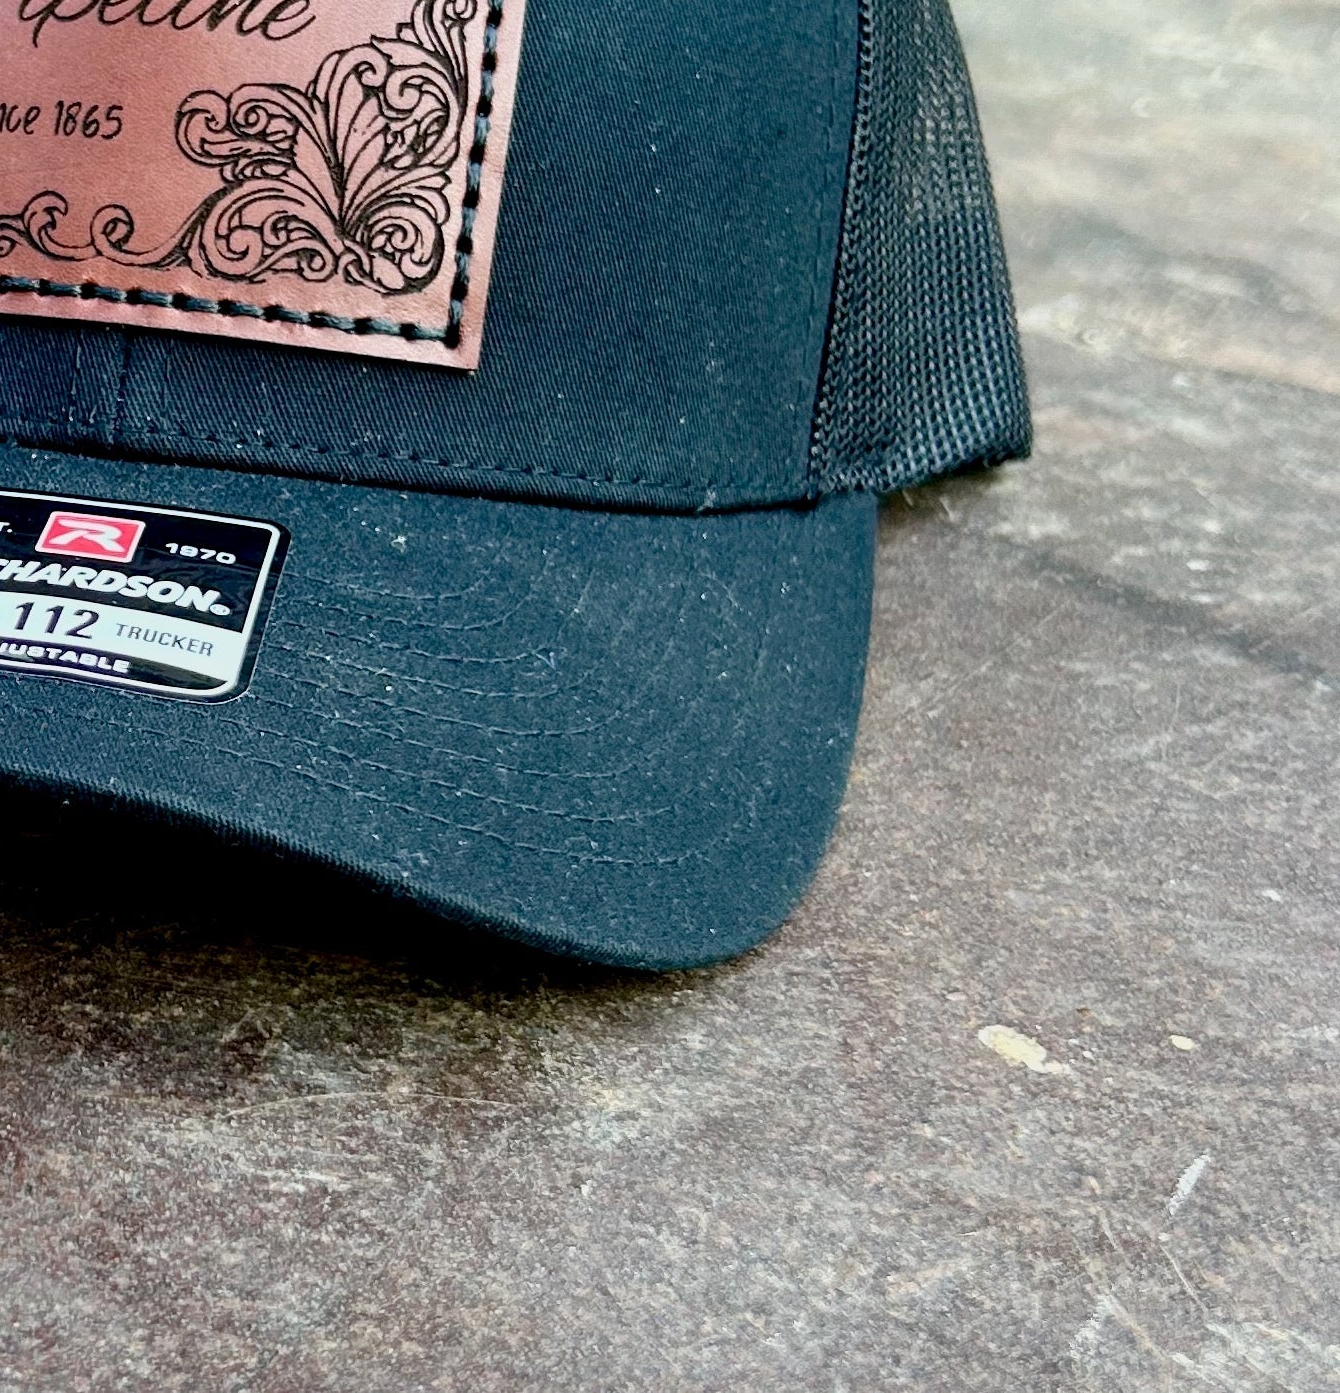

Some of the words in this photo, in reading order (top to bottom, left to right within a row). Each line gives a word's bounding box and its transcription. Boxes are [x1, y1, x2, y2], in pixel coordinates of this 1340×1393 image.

[54, 99, 125, 140] 1865
[164, 541, 238, 566] 1970
[12, 601, 100, 640] 112
[114, 622, 216, 658] TRUCKER
